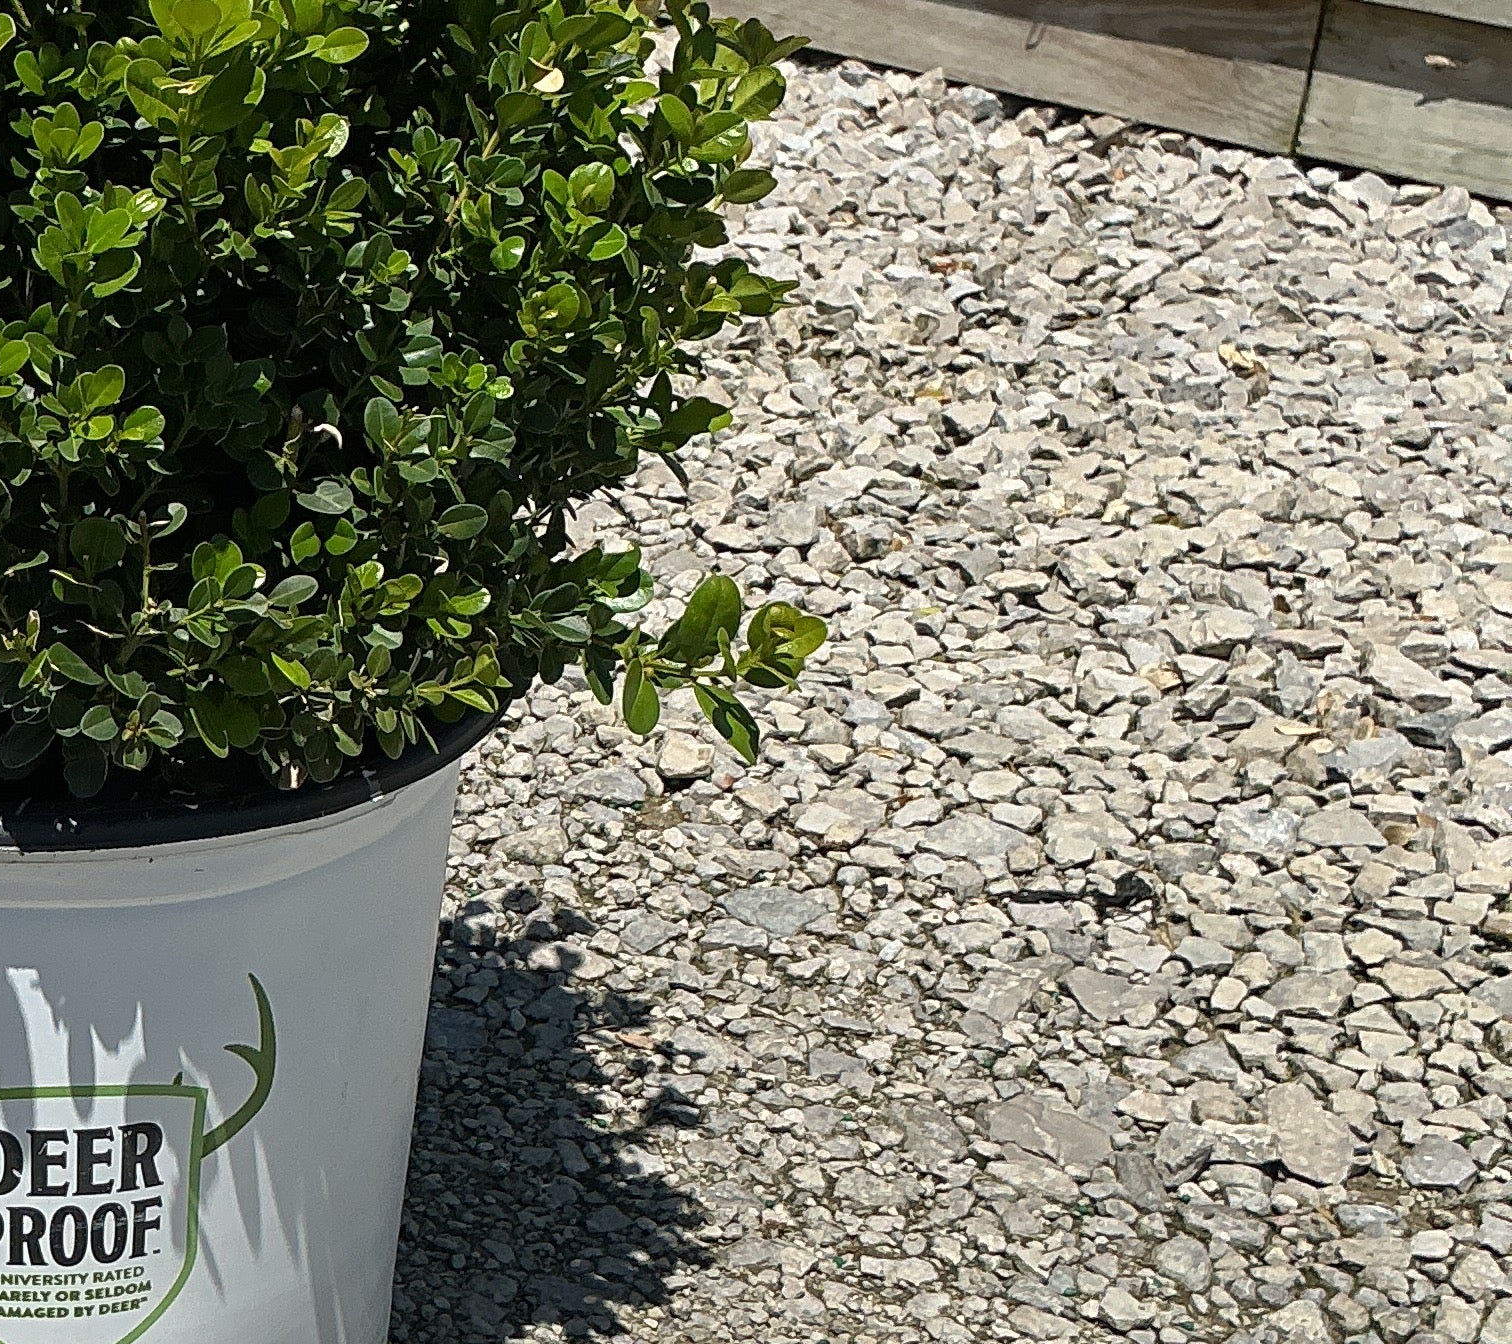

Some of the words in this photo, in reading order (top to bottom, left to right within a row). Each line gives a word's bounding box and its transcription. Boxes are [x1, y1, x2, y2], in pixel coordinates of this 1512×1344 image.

[92, 1265, 145, 1284] RATED
[55, 1289, 81, 1302] OR
[84, 1279, 152, 1301] SELDOM
[74, 1305, 95, 1318] BY
